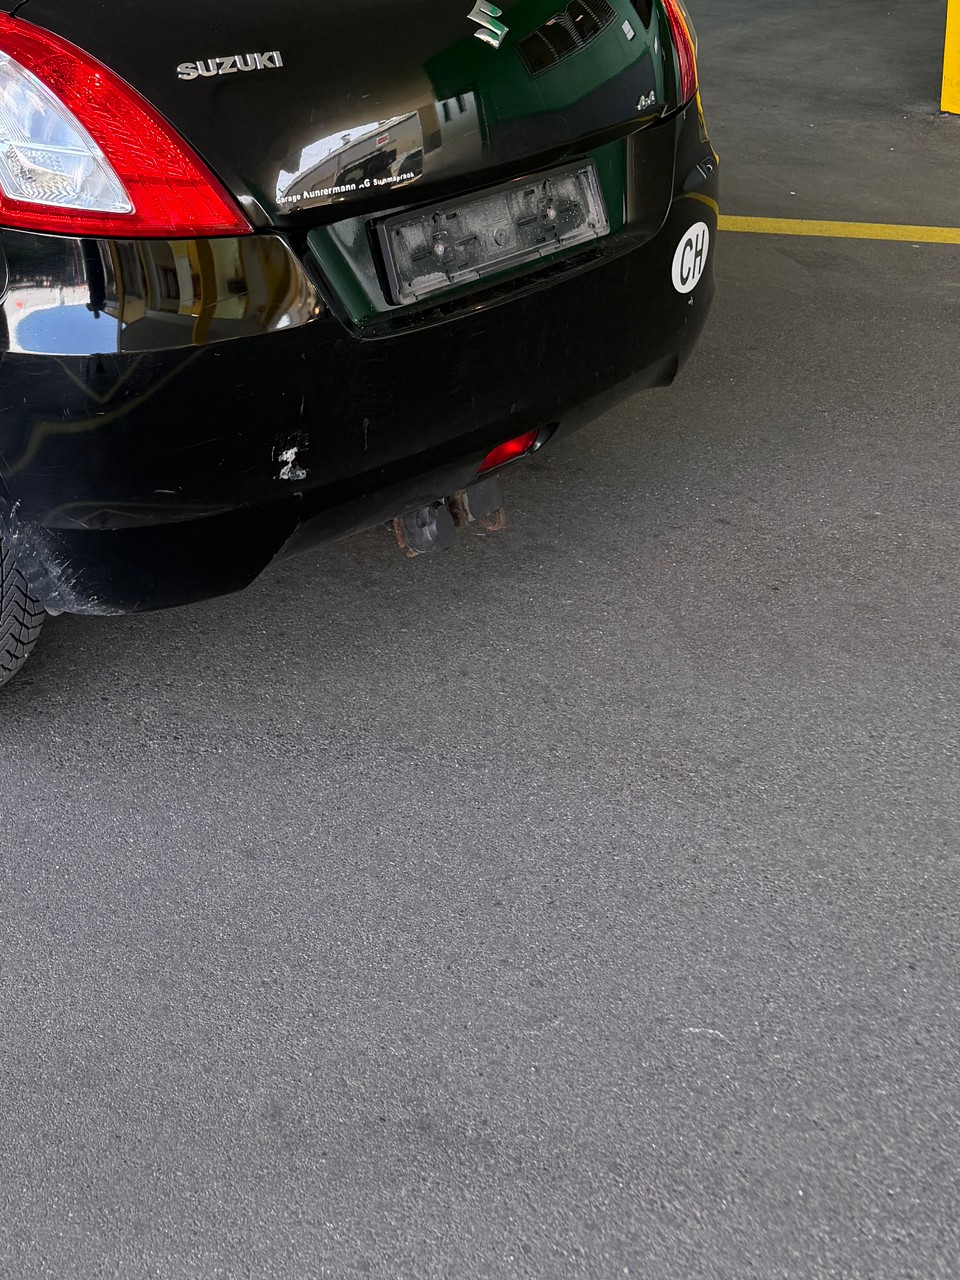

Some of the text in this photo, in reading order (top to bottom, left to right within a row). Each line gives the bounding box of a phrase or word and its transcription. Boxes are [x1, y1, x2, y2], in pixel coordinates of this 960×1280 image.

[177, 50, 284, 81] SUZUKI
[276, 194, 302, 204] Garage
[680, 229, 706, 287] CH
